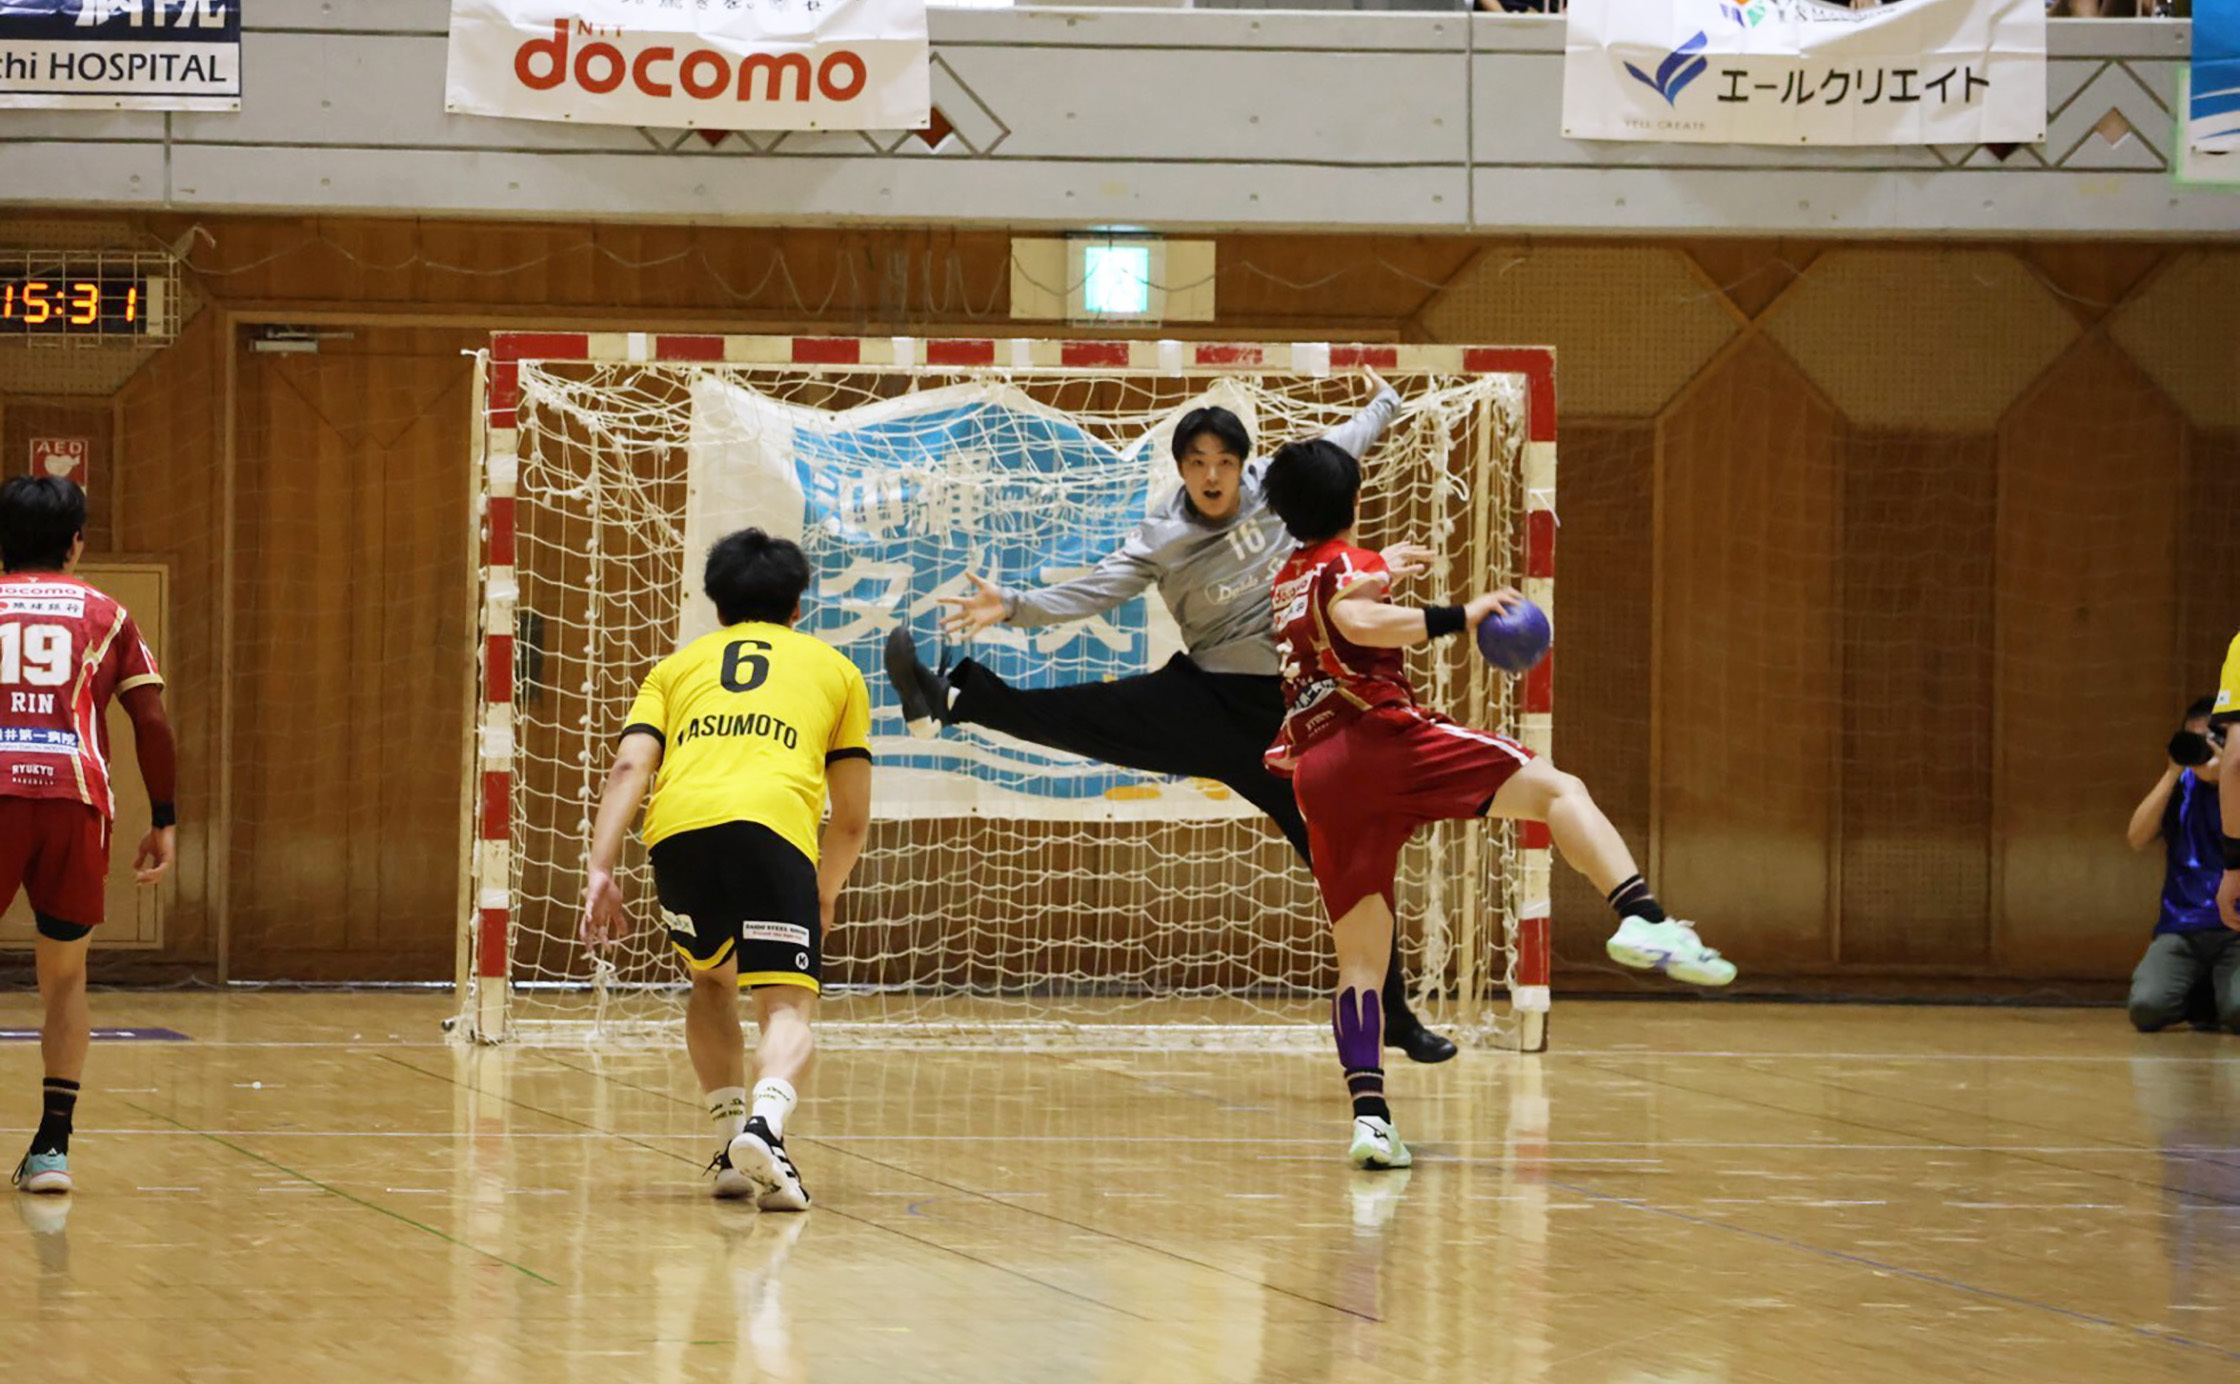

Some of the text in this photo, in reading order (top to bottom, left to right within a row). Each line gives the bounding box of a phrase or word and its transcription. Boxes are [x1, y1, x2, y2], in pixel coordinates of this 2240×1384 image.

[577, 19, 626, 38] NTT
[0, 52, 227, 82] hi HOSPITAL
[514, 18, 867, 102] docomo
[1717, 66, 1990, 105] エールクリエイト
[3, 282, 138, 324] 15:31
[1224, 517, 1266, 561] 16
[0, 622, 72, 686] 19
[720, 640, 772, 693] 6
[11, 692, 54, 714] RIN
